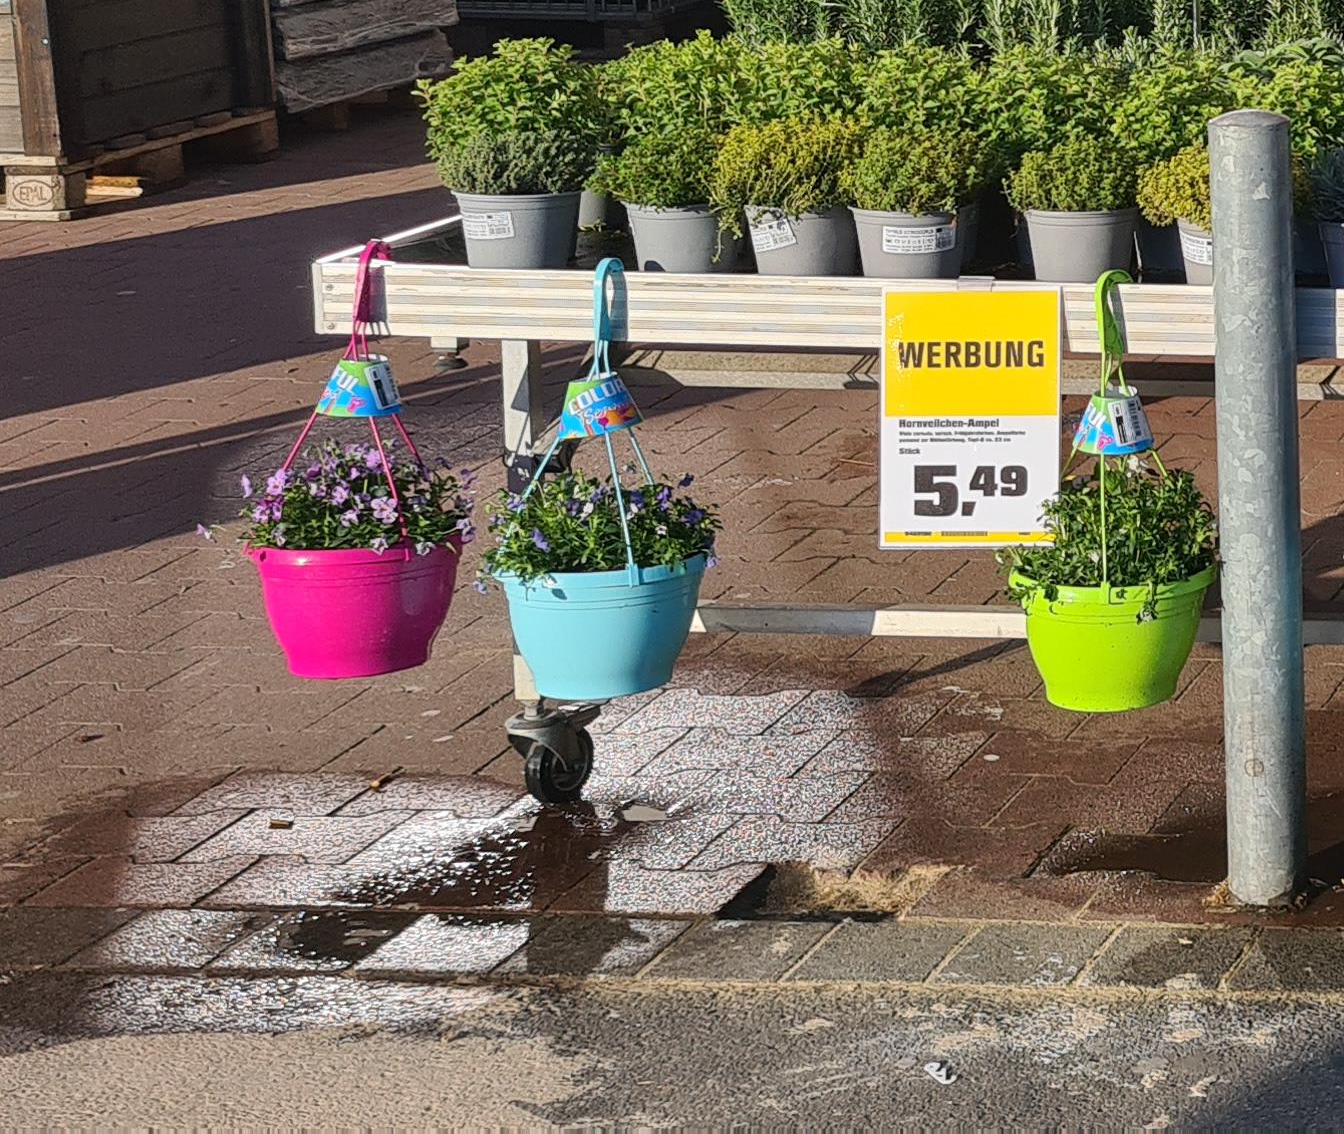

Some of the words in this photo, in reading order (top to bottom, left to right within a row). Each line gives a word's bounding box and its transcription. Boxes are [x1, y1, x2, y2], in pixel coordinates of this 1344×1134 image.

[899, 340, 1045, 368] WERBUNG
[899, 418, 999, 429] Hornveilchen-Ampel
[899, 447, 920, 455] Stück
[914, 464, 1028, 517] 5,49
